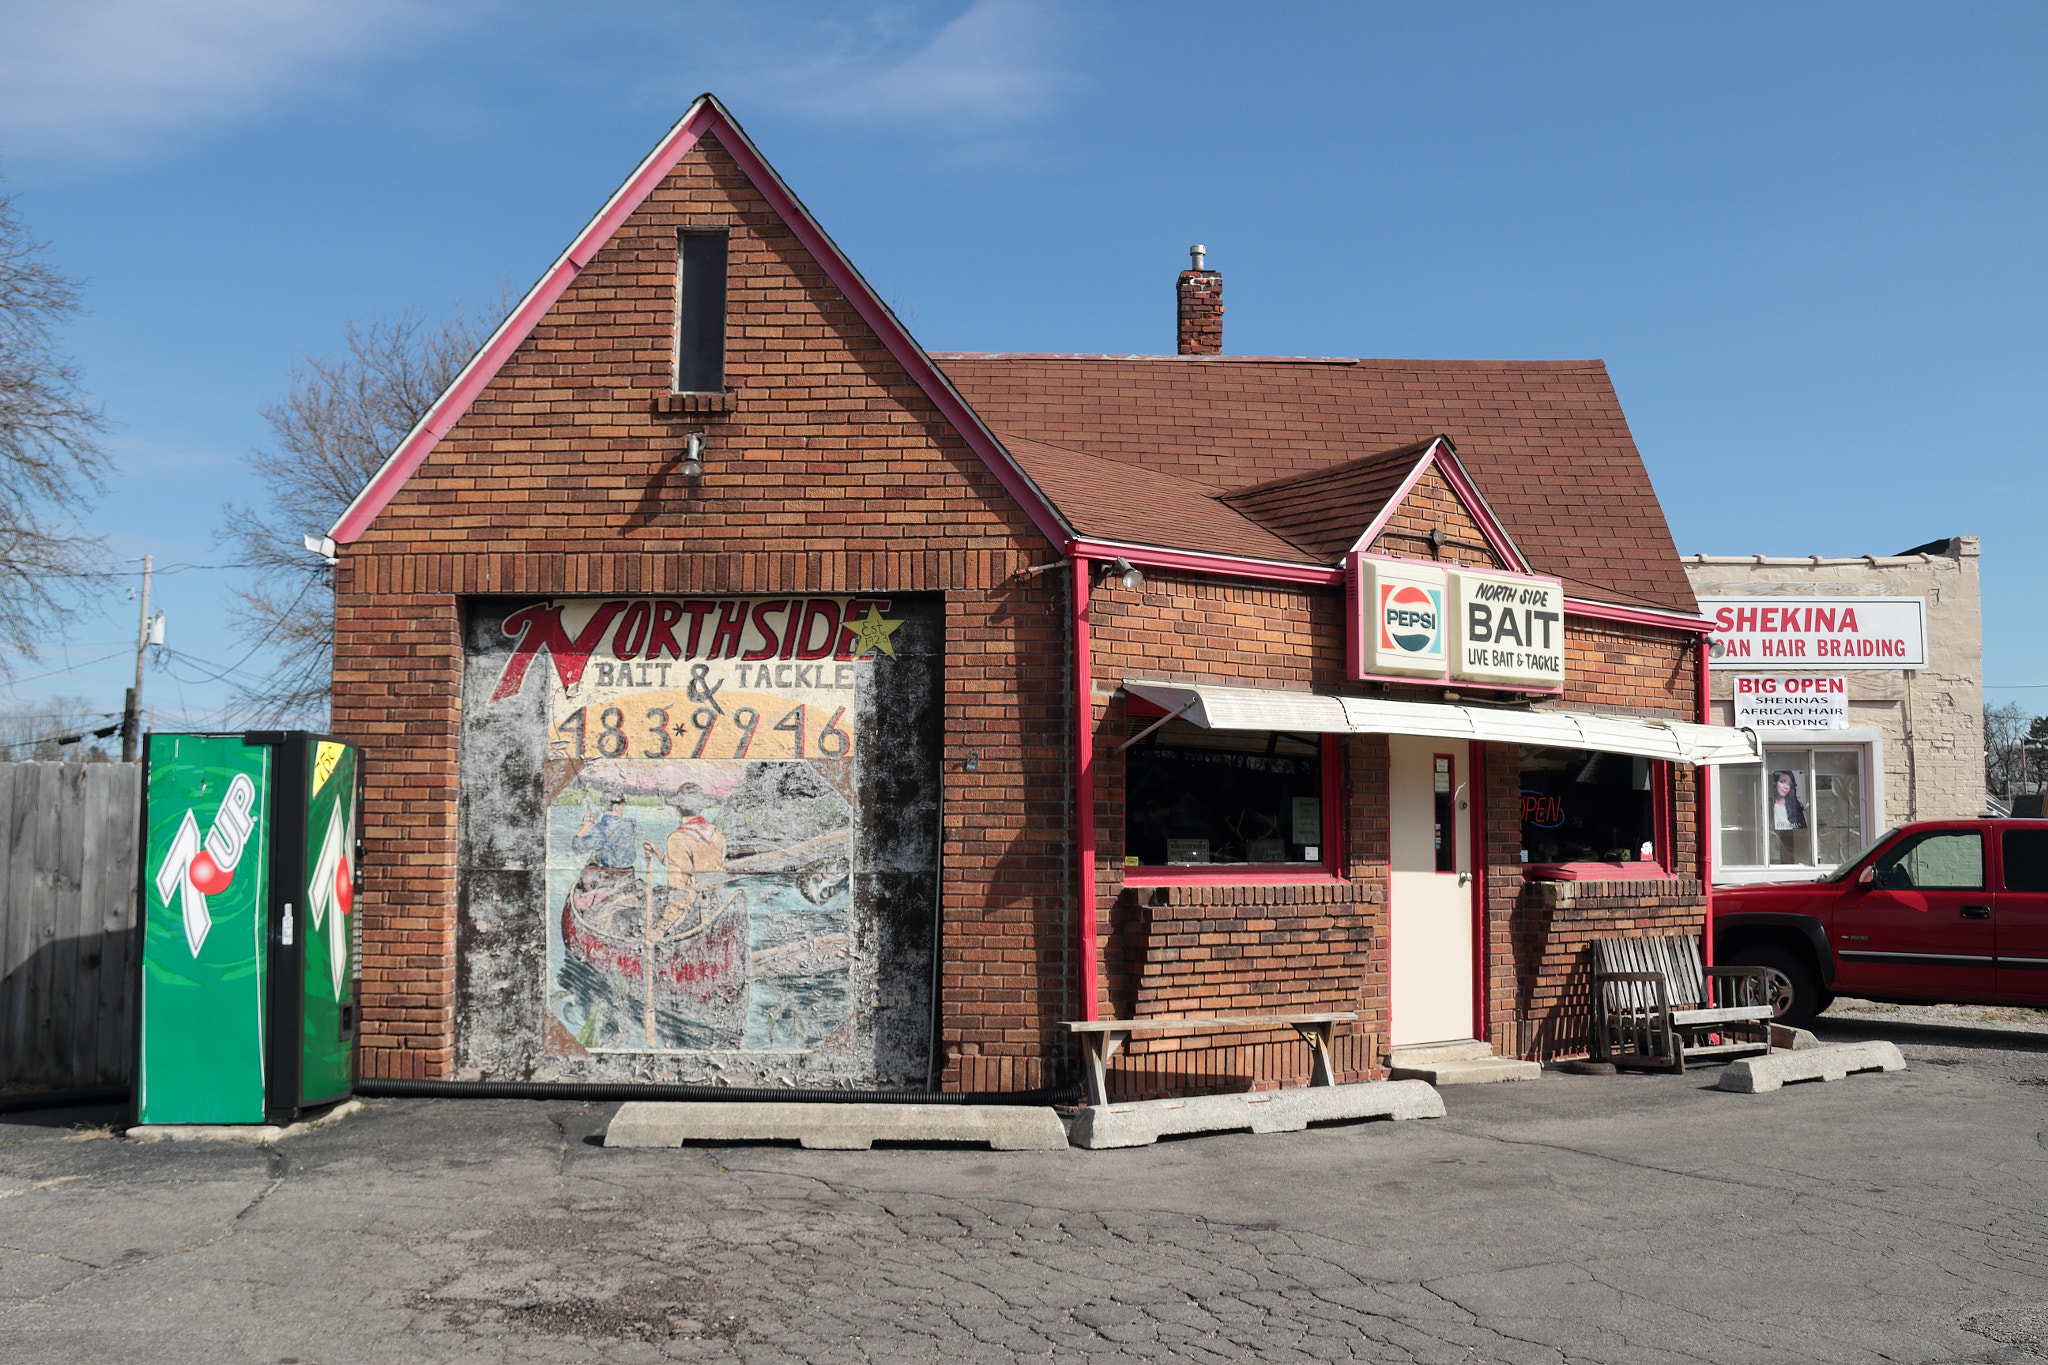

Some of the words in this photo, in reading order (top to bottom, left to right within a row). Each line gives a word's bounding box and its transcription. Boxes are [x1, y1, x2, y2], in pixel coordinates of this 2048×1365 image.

[1475, 582, 1517, 602] NORTH
[1520, 588, 1548, 607] SIDE
[1386, 608, 1436, 630] PEPSI
[1468, 602, 1559, 649] BAIT
[1715, 607, 1859, 632] SHEKINA
[488, 600, 892, 703] NORTHSIDE
[864, 632, 888, 649] 1923
[1715, 639, 1751, 657] AN
[1762, 639, 1806, 657] HAIR
[1817, 639, 1906, 657] BRAIDING
[1468, 648, 1489, 666] LIVE
[1492, 649, 1514, 668] BAIT
[1516, 653, 1524, 667] &
[1526, 654, 1560, 673] TACKLE
[596, 662, 672, 688] BAIT
[686, 663, 724, 716] &
[735, 663, 855, 690] TACKLE
[1738, 679, 1777, 694] BIG
[1784, 678, 1844, 694] OPEN
[1755, 696, 1828, 705] SHEKINAS
[1740, 708, 1804, 716] AFRICAN
[1808, 708, 1843, 716] HAIR
[1756, 719, 1828, 727] BRAIDING
